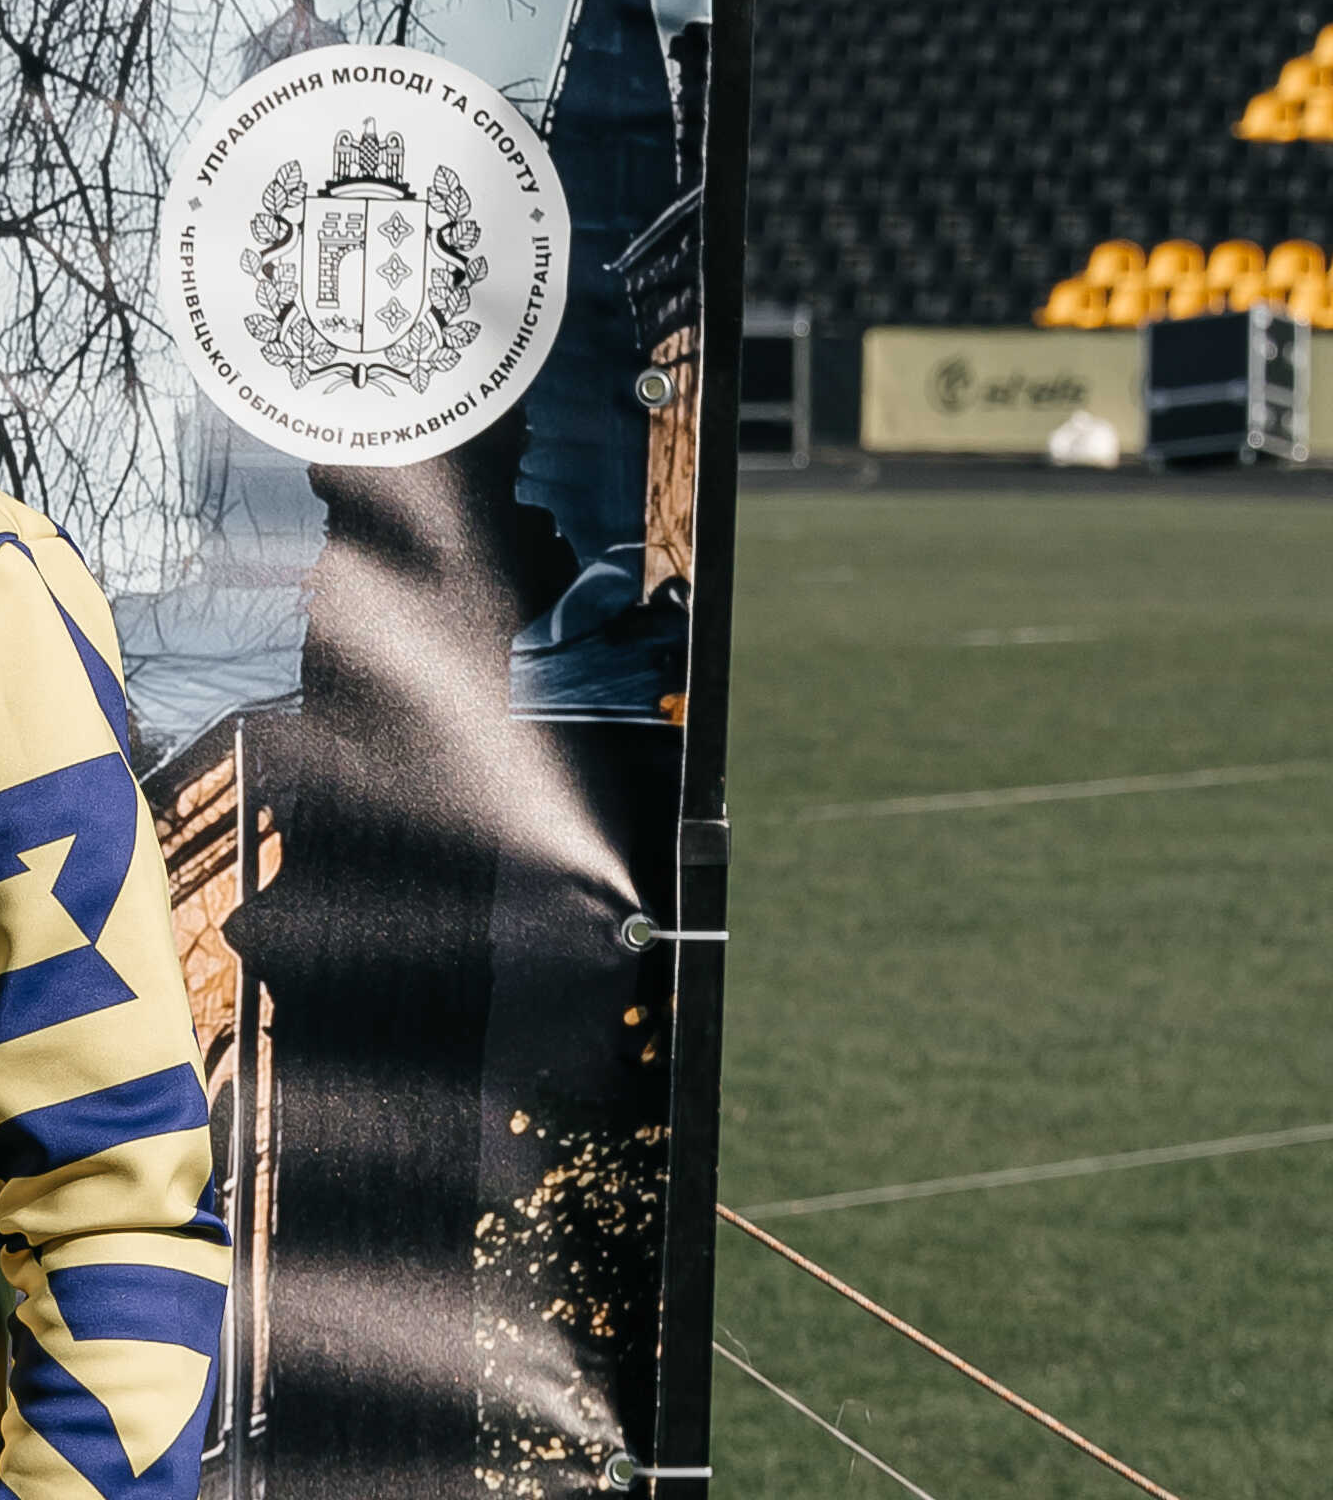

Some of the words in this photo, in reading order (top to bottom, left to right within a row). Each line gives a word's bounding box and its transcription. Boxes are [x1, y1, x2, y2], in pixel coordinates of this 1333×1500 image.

[197, 73, 324, 186] УПРАВЛІННЯ
[332, 66, 433, 96] МОЛОДІ
[442, 84, 469, 118] ТА
[474, 109, 540, 195] СПОРТУ
[179, 225, 242, 388] ЧЕРНІВЕЦЬКОЇ
[238, 384, 345, 447] ОБЛАСНОЇ
[350, 392, 481, 450] ДЕРЖАВНОЇ
[479, 235, 552, 400] АДМІНІСТРАЦІЇ
